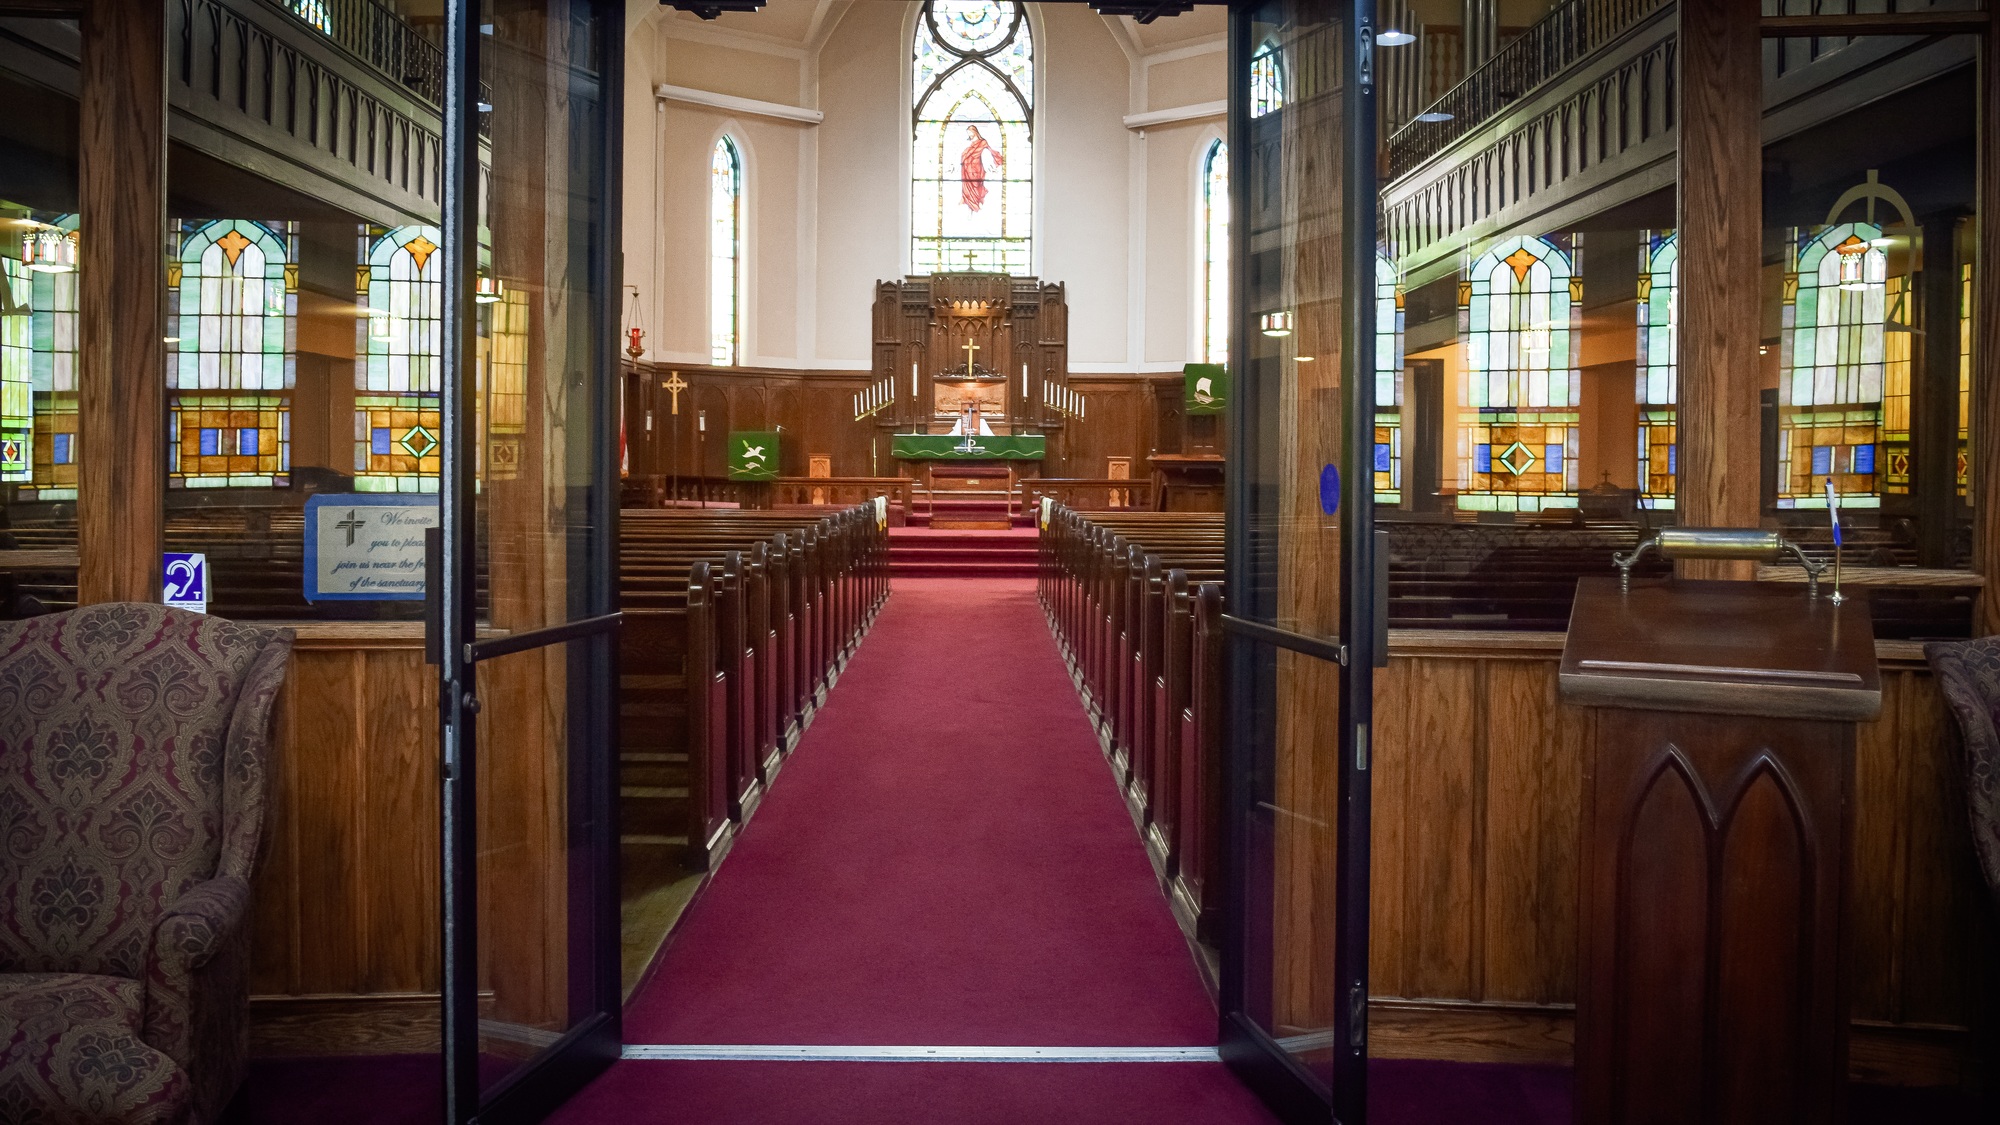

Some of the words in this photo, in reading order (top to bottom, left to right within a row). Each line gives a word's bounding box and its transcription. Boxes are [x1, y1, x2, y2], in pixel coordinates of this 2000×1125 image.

[381, 509, 410, 526] We
[404, 516, 433, 525] invite
[367, 539, 389, 552] you
[391, 538, 400, 547] to
[331, 560, 357, 575] join
[359, 561, 369, 569] us
[372, 561, 397, 569] near
[398, 558, 413, 569] the
[349, 576, 363, 591] of
[362, 577, 377, 587] the
[377, 578, 426, 592] sanctuary
[193, 591, 201, 599] T
